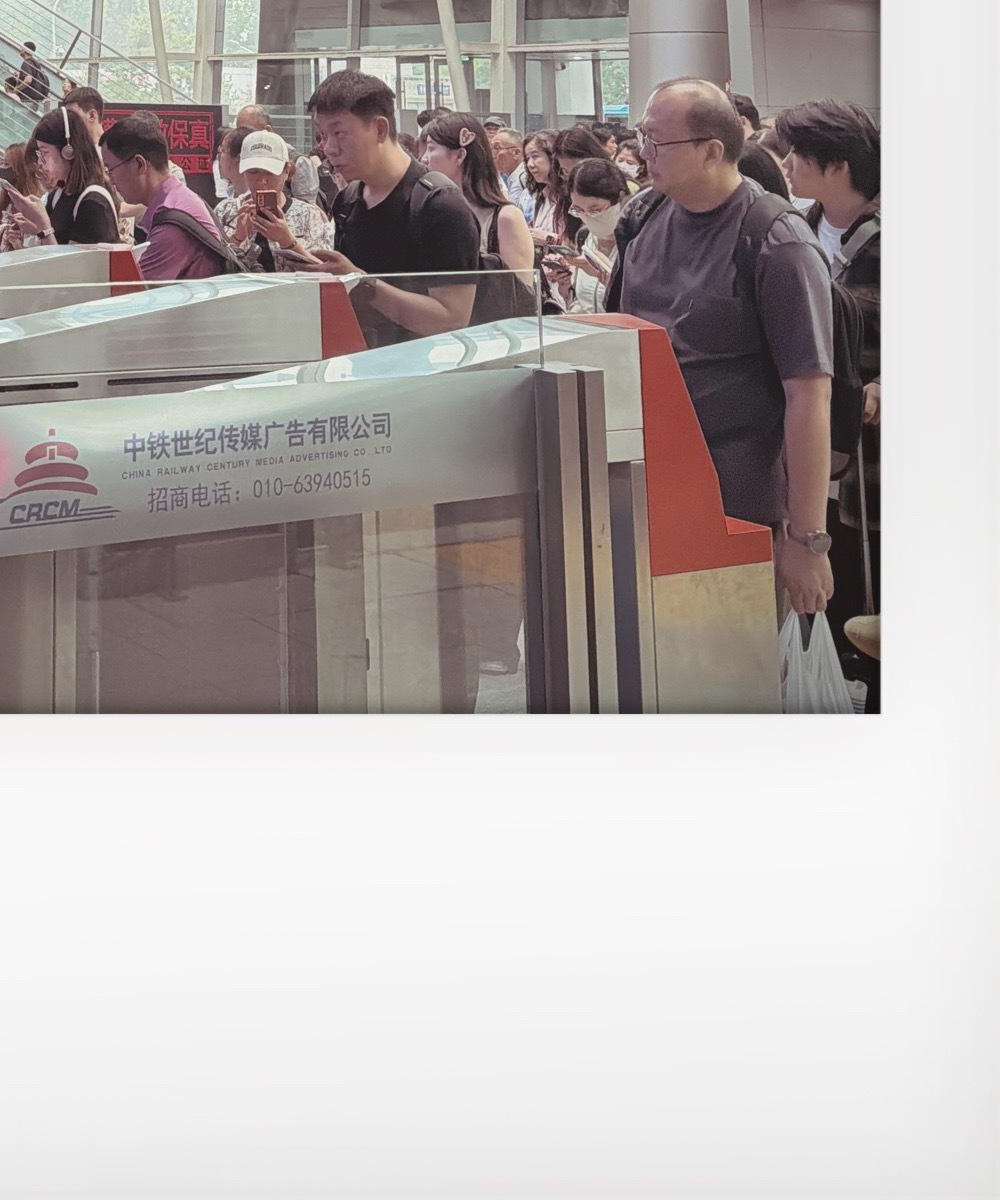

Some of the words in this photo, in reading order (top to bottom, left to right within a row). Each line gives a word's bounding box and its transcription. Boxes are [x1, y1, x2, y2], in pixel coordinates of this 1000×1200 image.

[123, 412, 392, 462] 中铁世纪传媒广告有限公司
[122, 469, 151, 480] CHINA
[157, 464, 201, 477] RAILWAY
[207, 459, 250, 472] CENTURY
[255, 455, 284, 466] MEDIA
[290, 449, 349, 463] ADVERTISING
[253, 467, 371, 498] 010-63940515
[9, 498, 81, 524] CRCM
